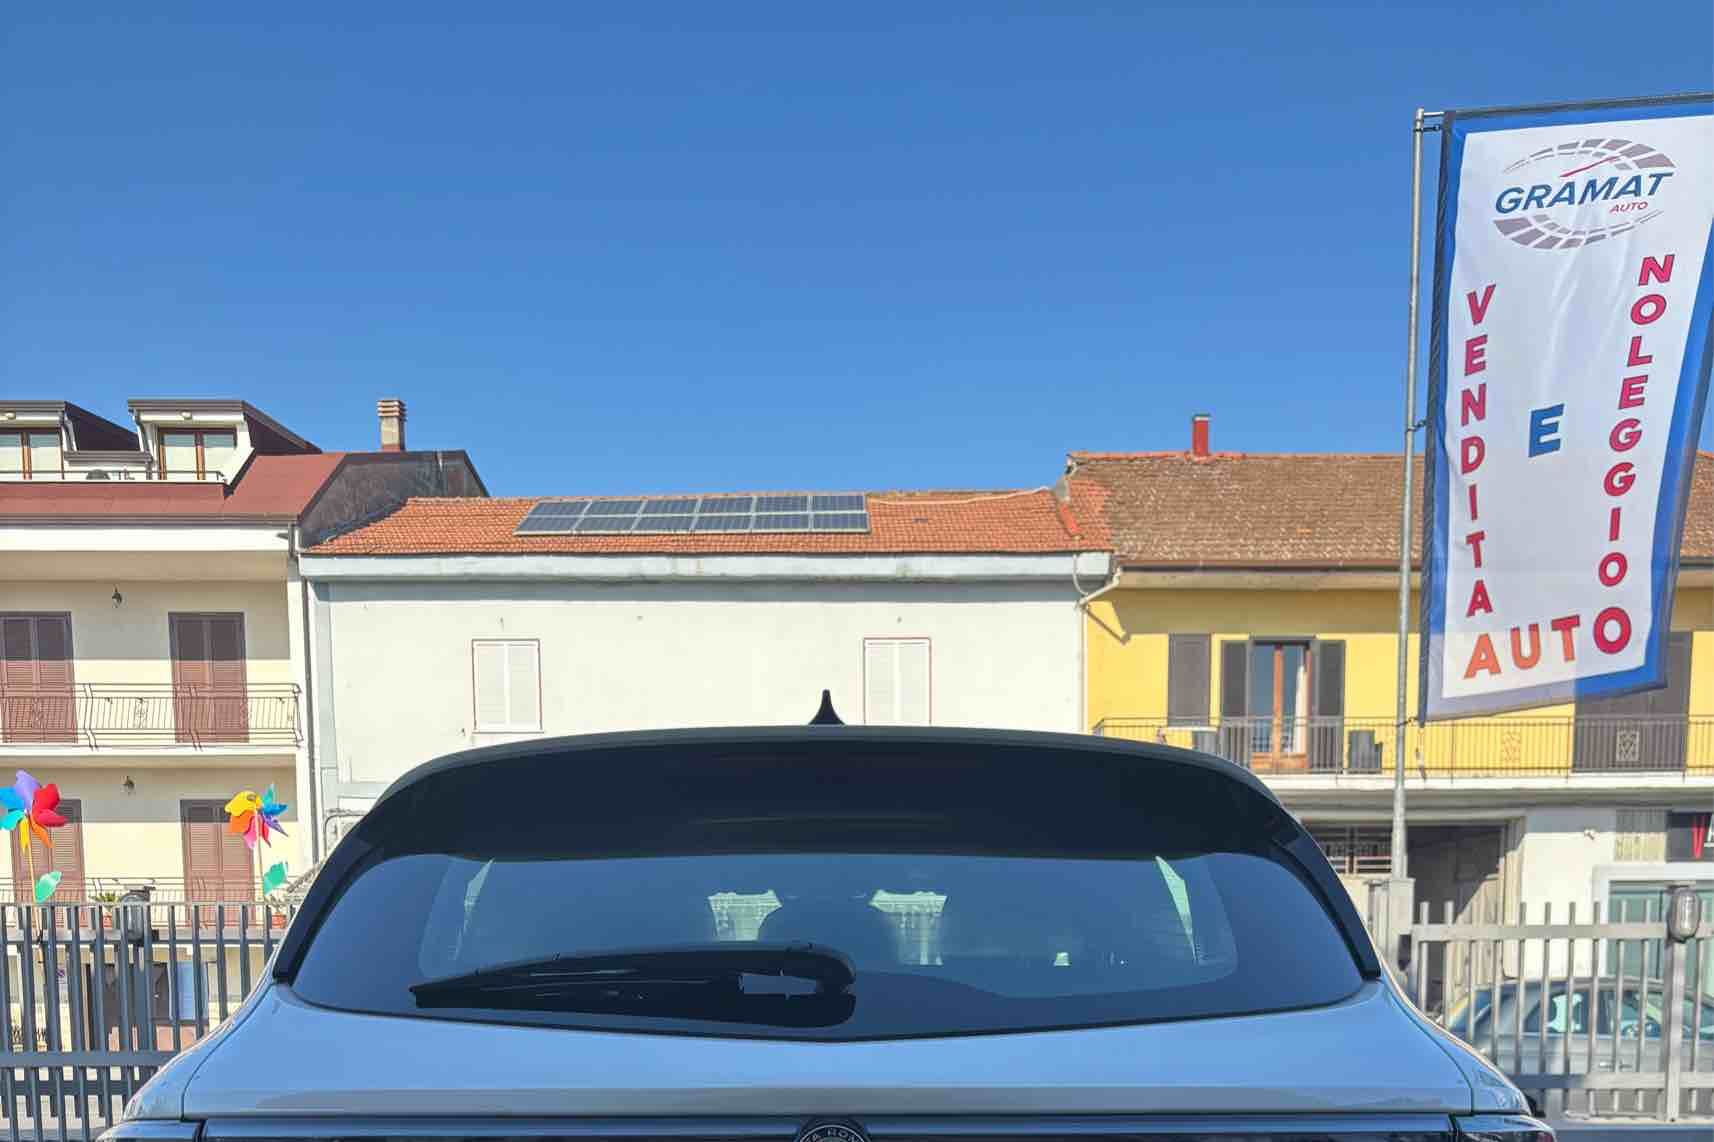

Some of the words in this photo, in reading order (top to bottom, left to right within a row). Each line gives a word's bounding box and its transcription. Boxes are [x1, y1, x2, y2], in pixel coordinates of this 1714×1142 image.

[1495, 172, 1675, 214] GRAMAT
[1609, 201, 1649, 213] AUTO
[1460, 283, 1497, 618] VENDITA
[1528, 403, 1565, 458] E
[1598, 253, 1675, 587] NOLEGGIO
[1463, 606, 1632, 679] AUTO
